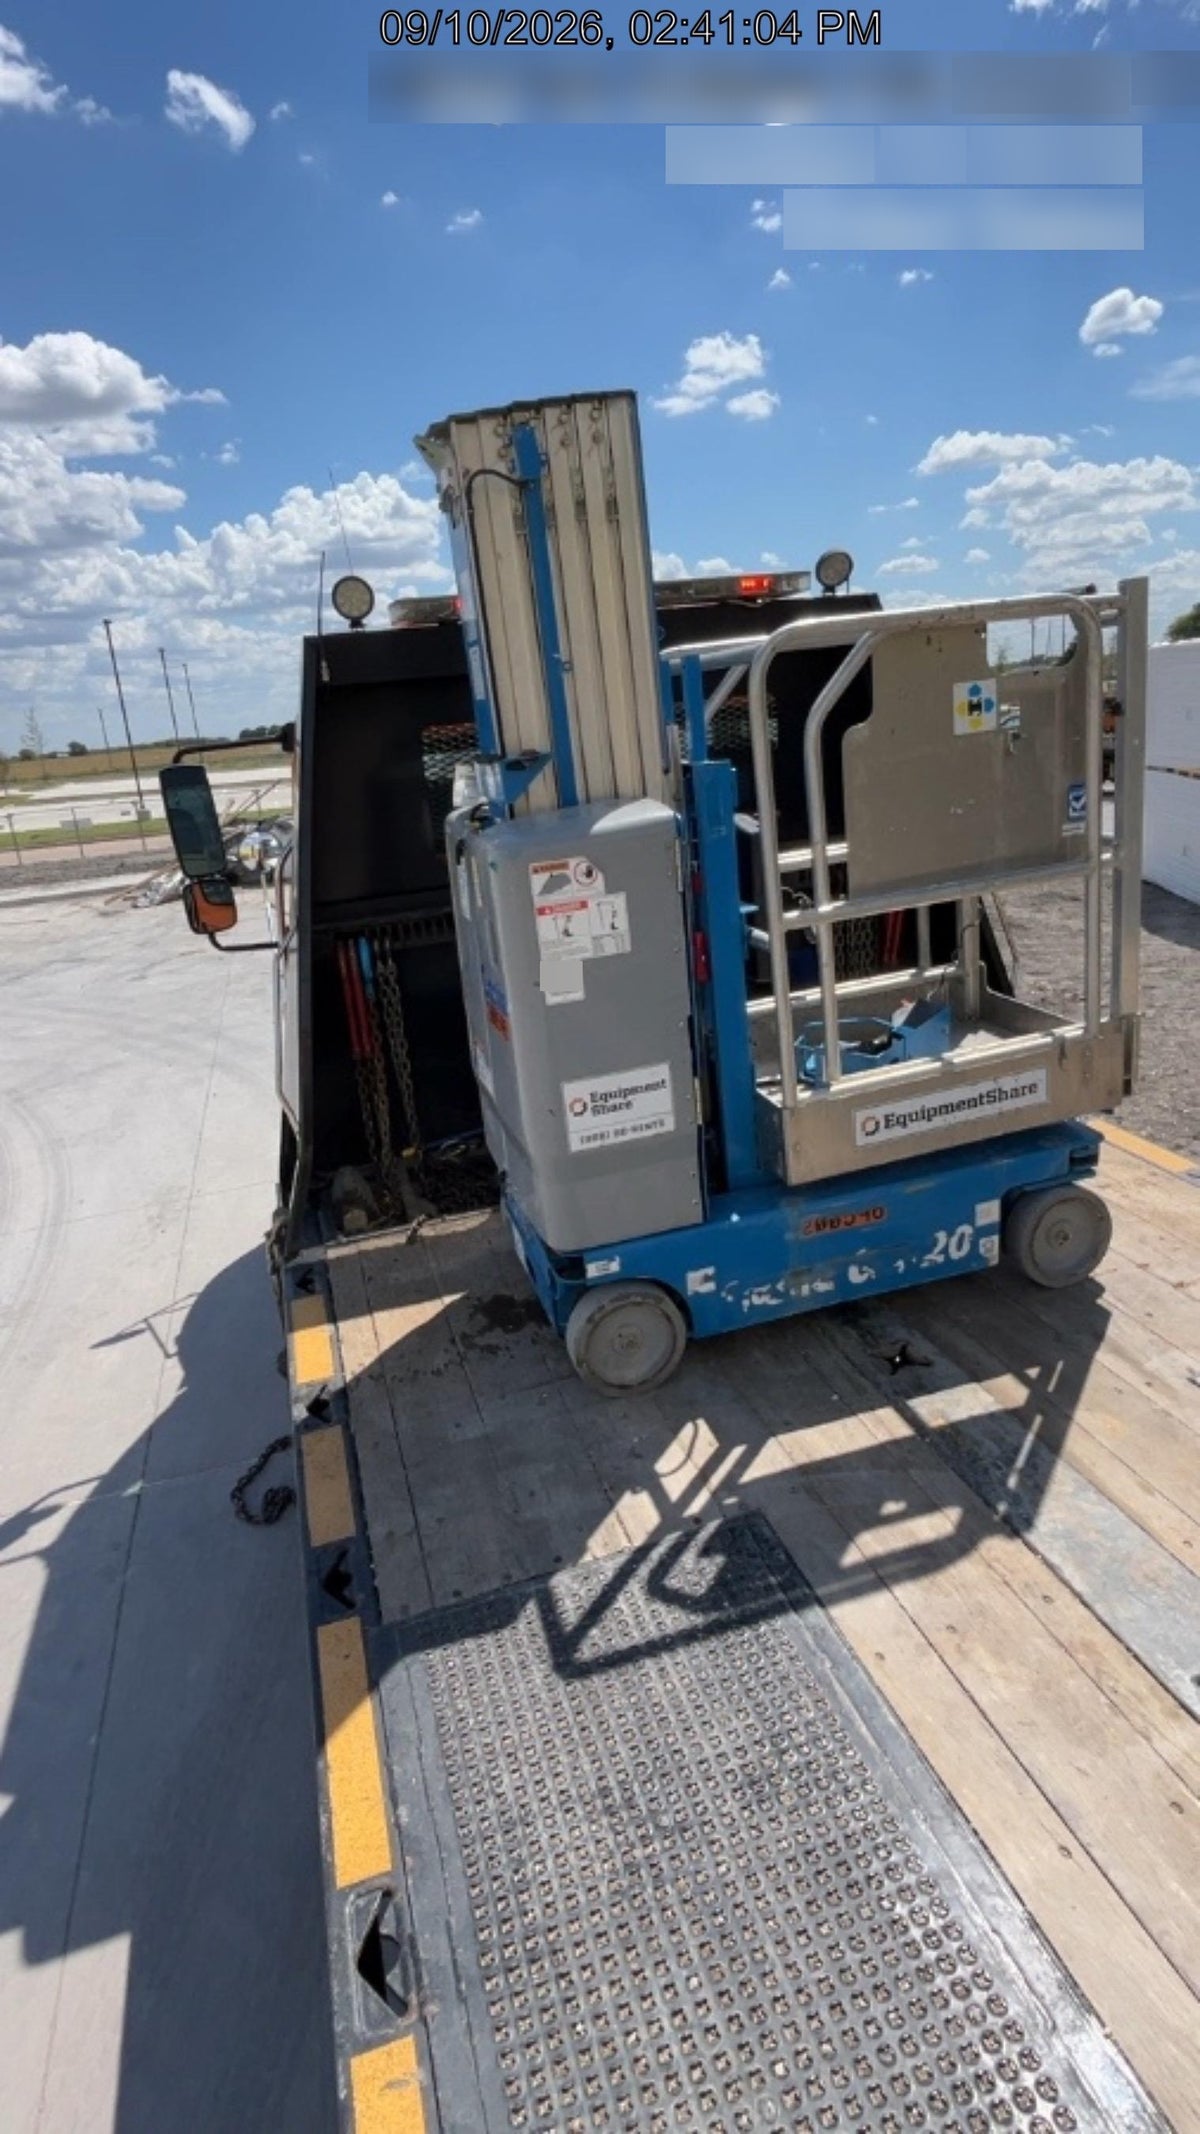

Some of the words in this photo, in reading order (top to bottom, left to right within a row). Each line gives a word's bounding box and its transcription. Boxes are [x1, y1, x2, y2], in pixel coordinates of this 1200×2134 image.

[589, 1078, 667, 1103] Equipment
[590, 1100, 634, 1117] Share
[883, 1081, 1038, 1129] EquipmentShare
